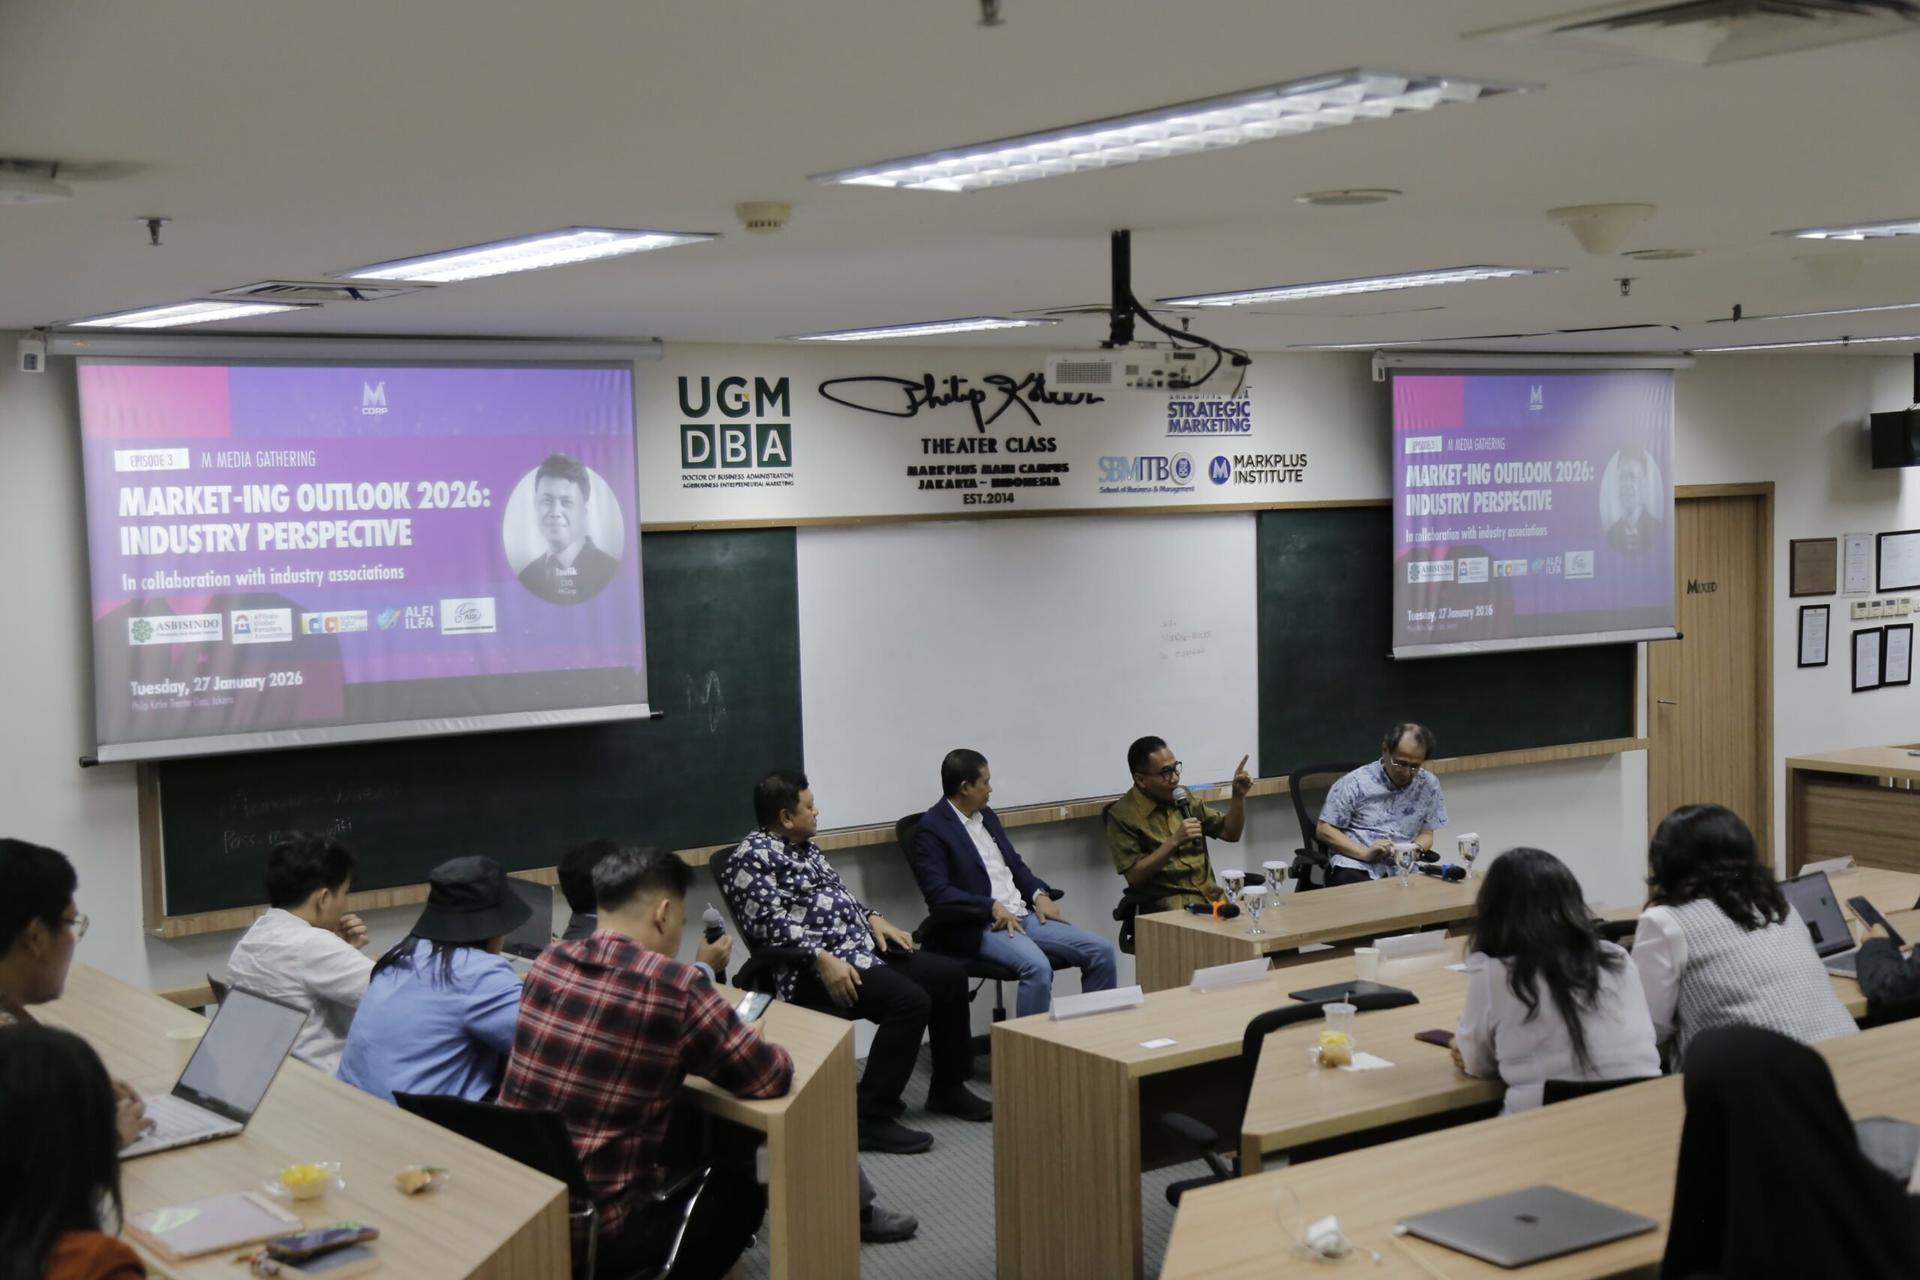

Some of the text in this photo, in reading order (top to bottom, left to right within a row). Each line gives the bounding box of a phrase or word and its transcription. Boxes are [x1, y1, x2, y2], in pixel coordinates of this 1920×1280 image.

[678, 376, 791, 418] UGM
[362, 407, 388, 415] CORP
[1167, 400, 1251, 418] STRATEGIC
[1167, 418, 1251, 433] MARKETING
[686, 429, 787, 463] DBA
[921, 436, 1057, 454] THEATER CLASS
[1455, 438, 1473, 450] MEDIA
[1474, 437, 1505, 450] GATHERING
[130, 454, 174, 468] EPISODE 3
[201, 449, 316, 469] M MEDIA GATHERING
[1234, 454, 1308, 468] MARKPLUS
[746, 472, 794, 480] ADMINISTRATION
[907, 465, 977, 476] MARKPLUS
[1019, 463, 1070, 473] CAMPUS
[1234, 469, 1304, 484] INSTITUTE
[1405, 461, 1595, 488] MARKET-ING OUTLOOK 2026:
[918, 478, 978, 490] JAKARTA
[991, 477, 1061, 488] INDONESIA
[119, 480, 492, 516] MARKET-ING OUTLOOK 2026:
[963, 493, 1015, 505] EST.2014
[1406, 489, 1553, 516] INDUSTRY PERSPECTIVE
[120, 518, 413, 556] INDUSTRY PERSPECTIVE
[1415, 527, 1460, 542] collaboration
[1461, 525, 1477, 540] with
[1478, 525, 1506, 541] industry
[1508, 523, 1548, 538] associations
[122, 563, 405, 591] In collaboration with industry associations
[405, 605, 433, 617] ALFI
[1447, 607, 1474, 619] January
[156, 619, 220, 632] ASBISINDO
[405, 617, 434, 630] ILFA
[131, 671, 303, 697] Tuesday, 27 January 2026
